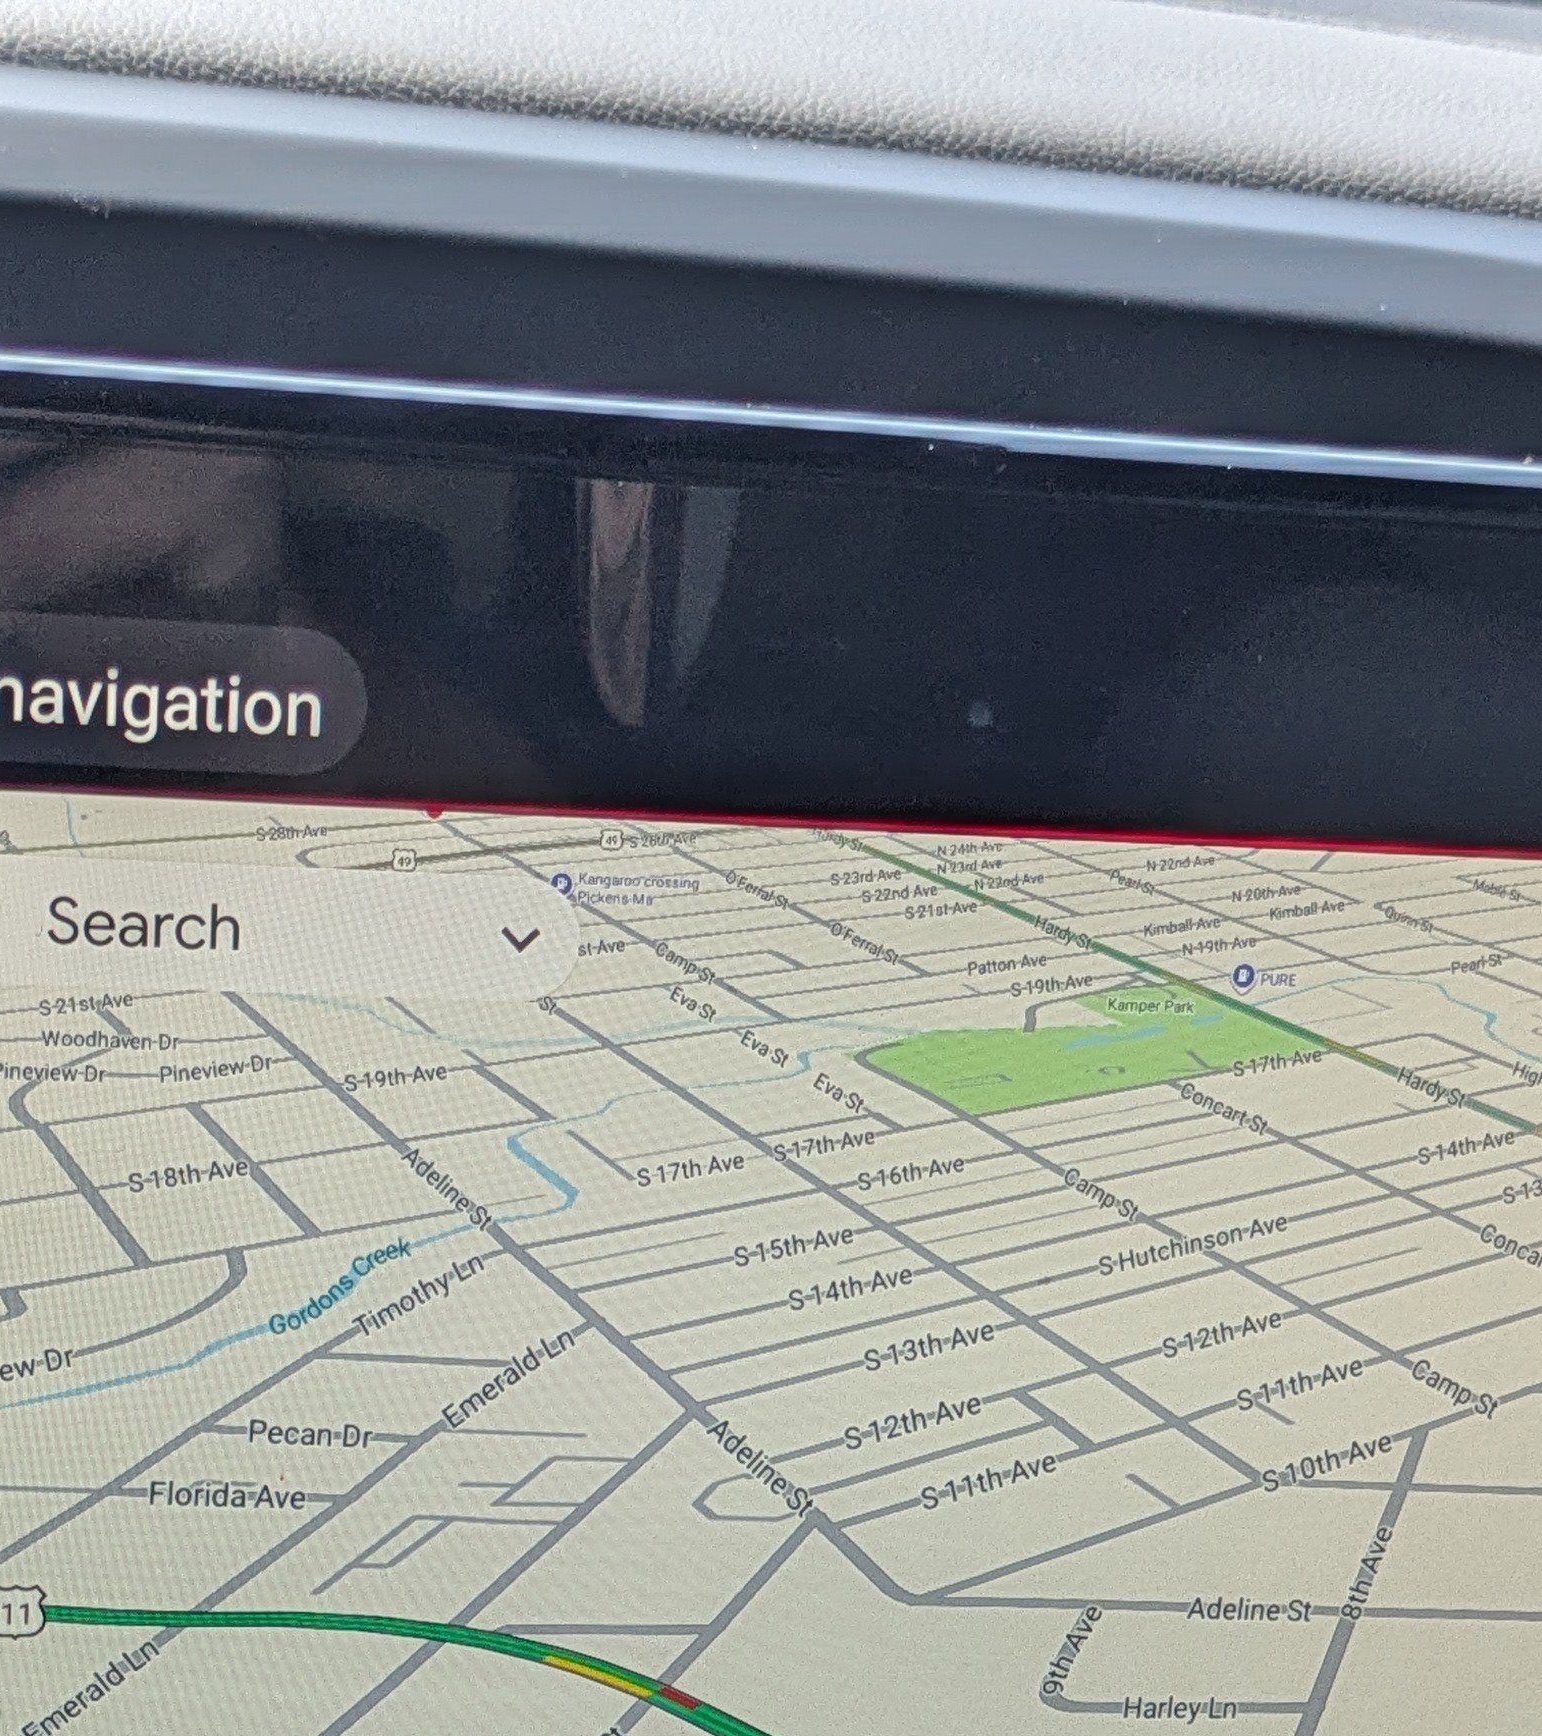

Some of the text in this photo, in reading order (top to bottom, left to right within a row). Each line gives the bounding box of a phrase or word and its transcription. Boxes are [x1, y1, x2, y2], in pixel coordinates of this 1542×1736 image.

[47, 896, 240, 951] Search
[655, 942, 716, 985] Camp St
[967, 953, 1047, 976] Patton Ave
[1261, 974, 1296, 987] PURE
[39, 992, 133, 1016] S 21st Ave
[1107, 999, 1194, 1017] Kamper Park
[42, 1031, 179, 1052] Woodhaven Dr
[740, 1031, 789, 1068] Eva St
[77, 1065, 105, 1083] Dr
[160, 1054, 272, 1084] Pineview Dr
[343, 1063, 448, 1092] S 19th Ave
[1397, 1067, 1468, 1107] Hardy St
[128, 1158, 248, 1194] S 18th Ave
[401, 1146, 493, 1231] Adeline St
[1063, 1167, 1140, 1221] Camp St
[1098, 1213, 1289, 1277] S Hutchinson Ave
[268, 1237, 412, 1336] Gordons Creek
[351, 1253, 485, 1338] Timothy Ln
[45, 1348, 74, 1373] Dr
[864, 1321, 996, 1372] S 13th Ave
[439, 1327, 576, 1431] Emerald Ln
[1411, 1359, 1500, 1419] Camp St
[248, 1421, 373, 1448] Pecan Dr
[844, 1395, 983, 1450] S 12th Ave
[707, 1419, 814, 1517] Adeline St
[921, 1453, 1058, 1510] S 11th Ave
[1261, 1434, 1393, 1491] S 10th Ave
[148, 1481, 306, 1509] Florida Ave
[1339, 1526, 1394, 1620] 8th Ave
[1, 1602, 31, 1626] 11
[1187, 1598, 1311, 1622] Adeline St
[121, 1638, 161, 1673] Ln
[1042, 1603, 1103, 1695] 9th Ave
[1124, 1697, 1237, 1723] Harley Ln
